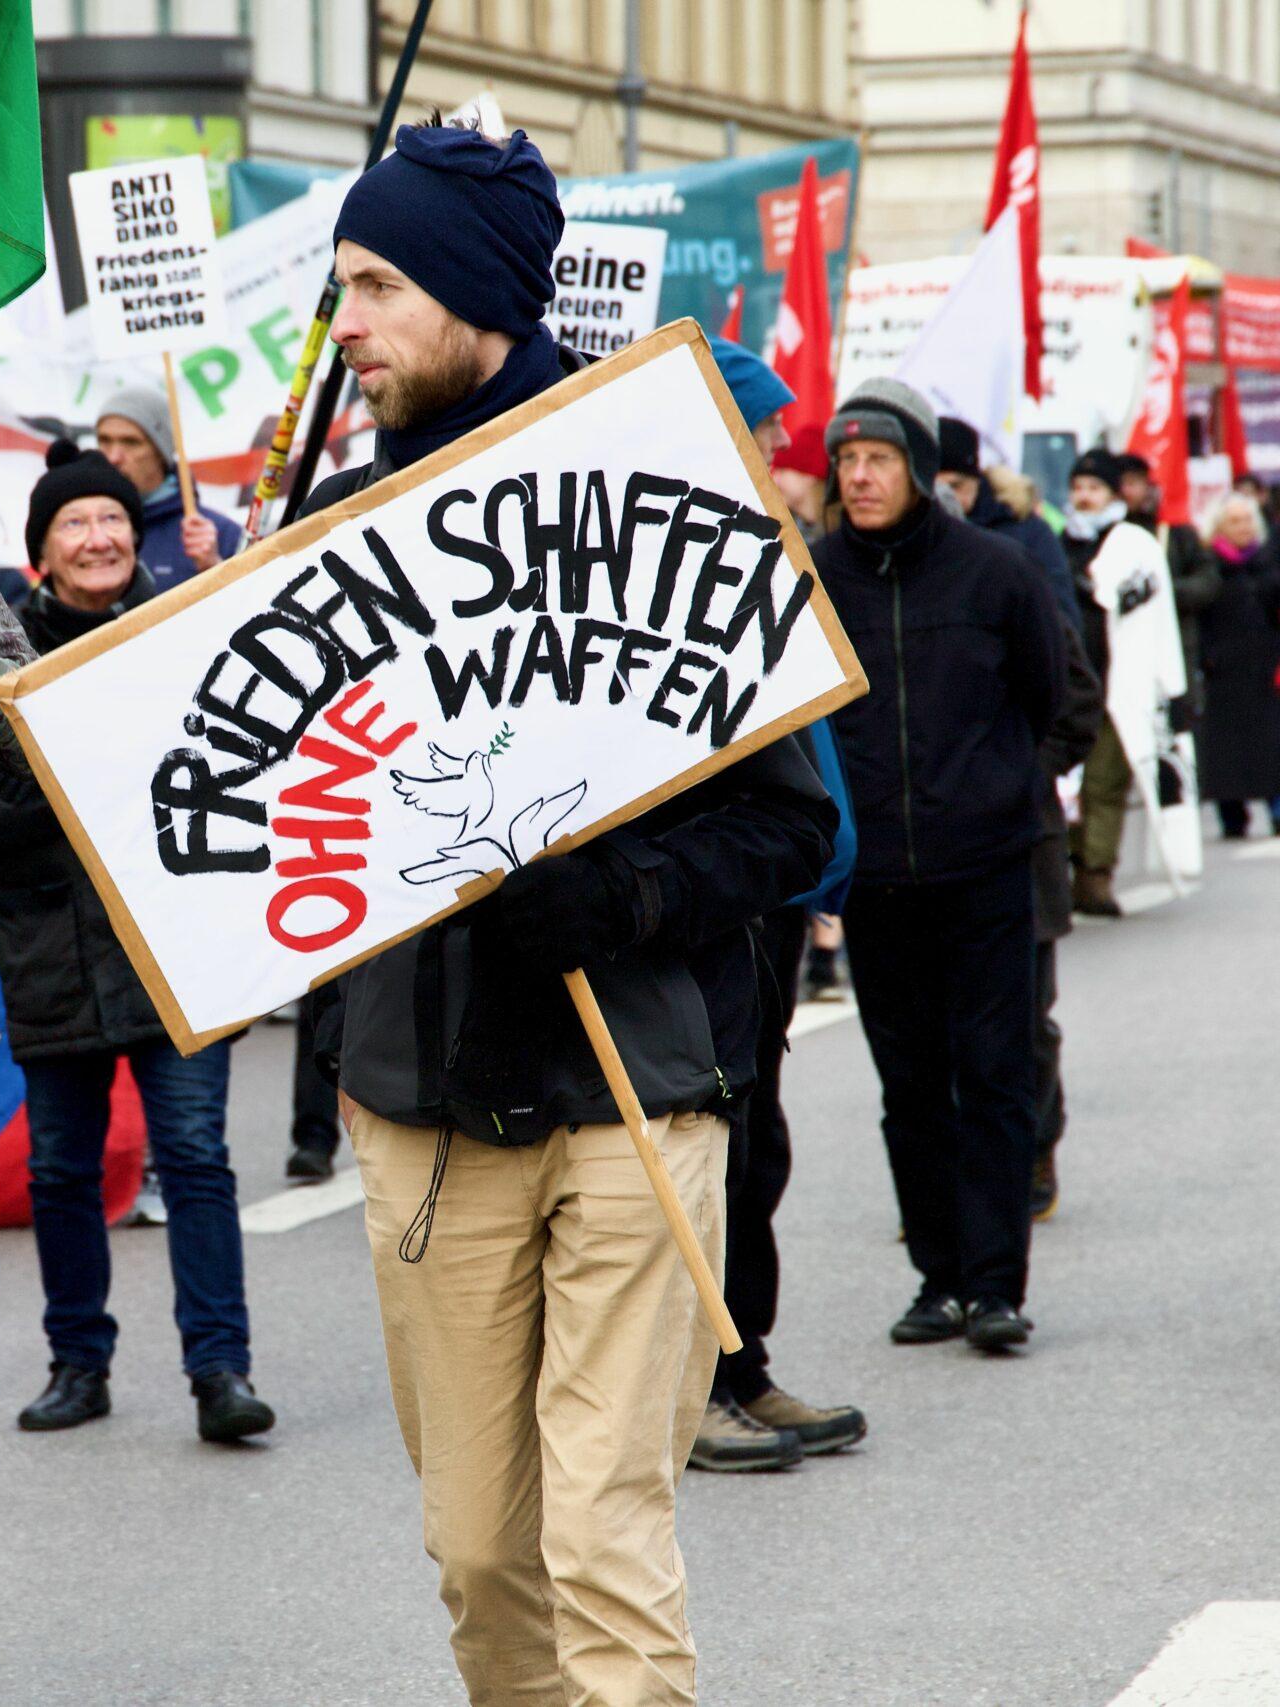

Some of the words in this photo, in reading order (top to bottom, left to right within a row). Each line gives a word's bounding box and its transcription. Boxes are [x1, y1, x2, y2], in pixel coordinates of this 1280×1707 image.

[111, 172, 173, 200] ANTI
[113, 197, 175, 223] SIKO
[116, 220, 178, 243] DEMO
[95, 245, 208, 271] Friedens-
[554, 247, 647, 292] eine
[122, 288, 206, 312] kriegs-
[125, 309, 205, 334] tüchtig
[180, 305, 303, 419] PE
[427, 469, 814, 676] SCHAFFEN
[265, 679, 418, 953] OHNE
[425, 614, 758, 750] WAFFEN
